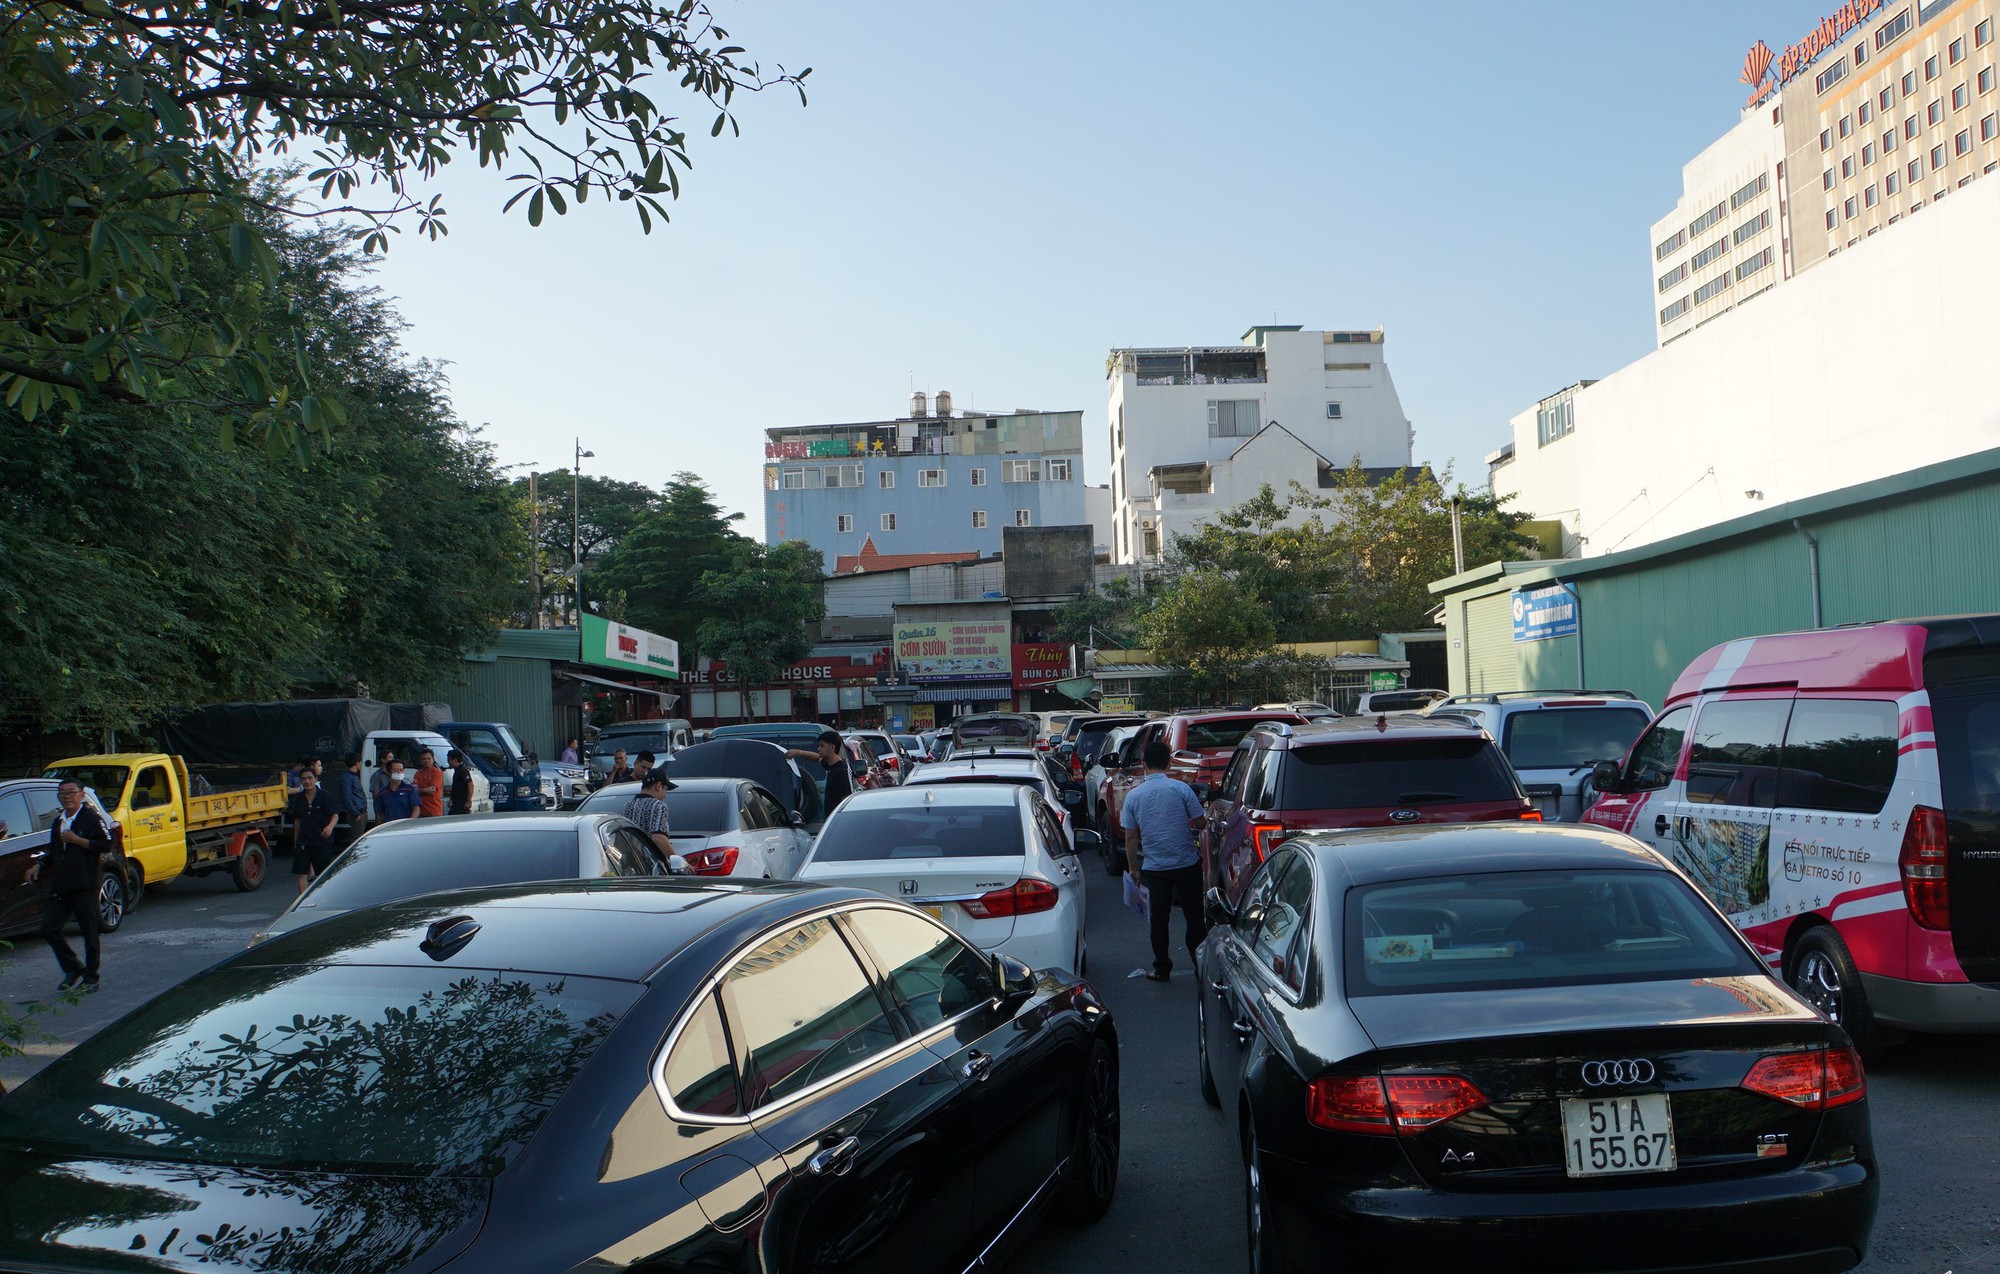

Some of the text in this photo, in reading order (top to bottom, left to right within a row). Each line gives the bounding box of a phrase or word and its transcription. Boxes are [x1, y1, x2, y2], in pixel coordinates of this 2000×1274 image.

[1777, 45, 1800, 82] TẬP
[1801, 15, 1837, 64] ĐOÀN
[765, 442, 807, 458] QUEEN
[925, 627, 937, 636] 16
[900, 638, 946, 657] CƠM SƯỜN
[681, 670, 709, 683] THE
[782, 666, 831, 680] HOUSE
[1022, 667, 1042, 678] BÚN
[1785, 837, 1871, 863] KẾT NỐI TRỰC TIẾP
[1785, 862, 1862, 885] GA METRO SỐ 10
[1588, 1100, 1644, 1134] 51A
[1441, 1148, 1476, 1164] A4
[1573, 1133, 1668, 1173] 155.67
